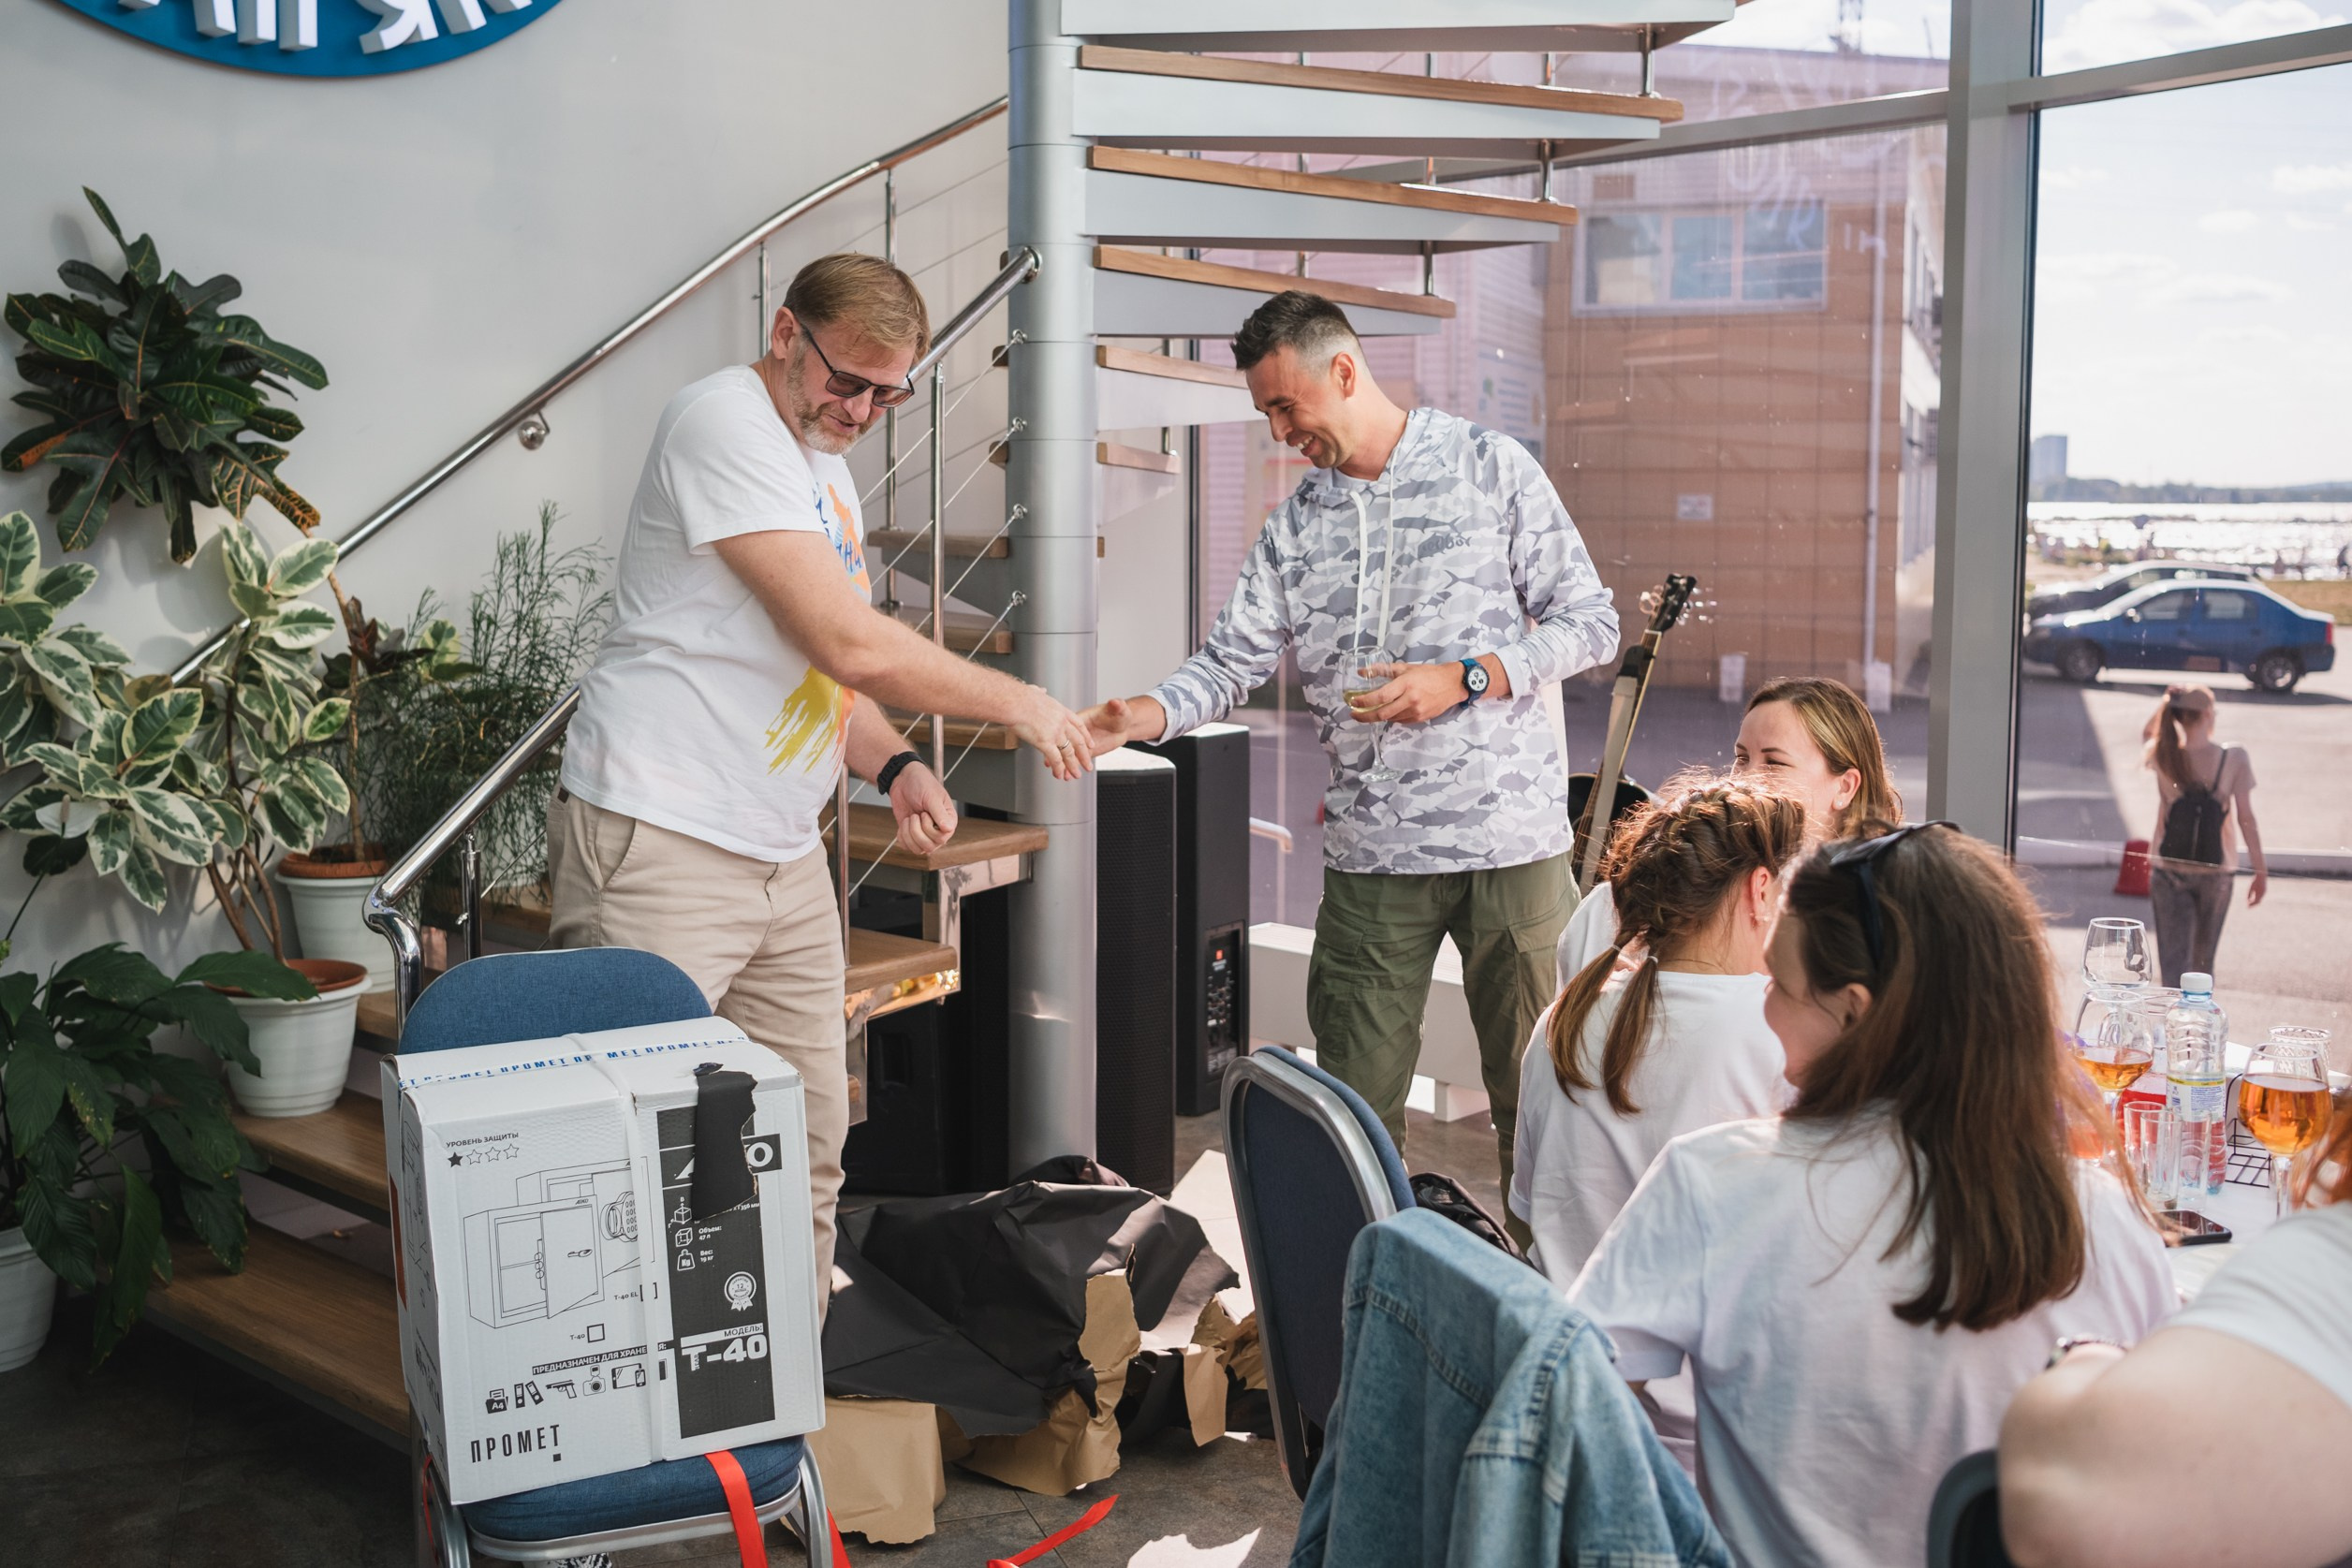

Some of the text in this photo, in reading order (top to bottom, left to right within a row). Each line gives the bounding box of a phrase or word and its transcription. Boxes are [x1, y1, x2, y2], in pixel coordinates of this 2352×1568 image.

[446, 1132, 520, 1148] УРОВЕНЬ ЗАЩИТЫ
[724, 1325, 763, 1338] МОДЕЛЬ:
[532, 1353, 601, 1375] ПРЕДНАЗНАЧЕН
[600, 1351, 620, 1363] ДЛЯ
[681, 1333, 768, 1371] T-40
[470, 1424, 561, 1463] ПРОМЕТ
